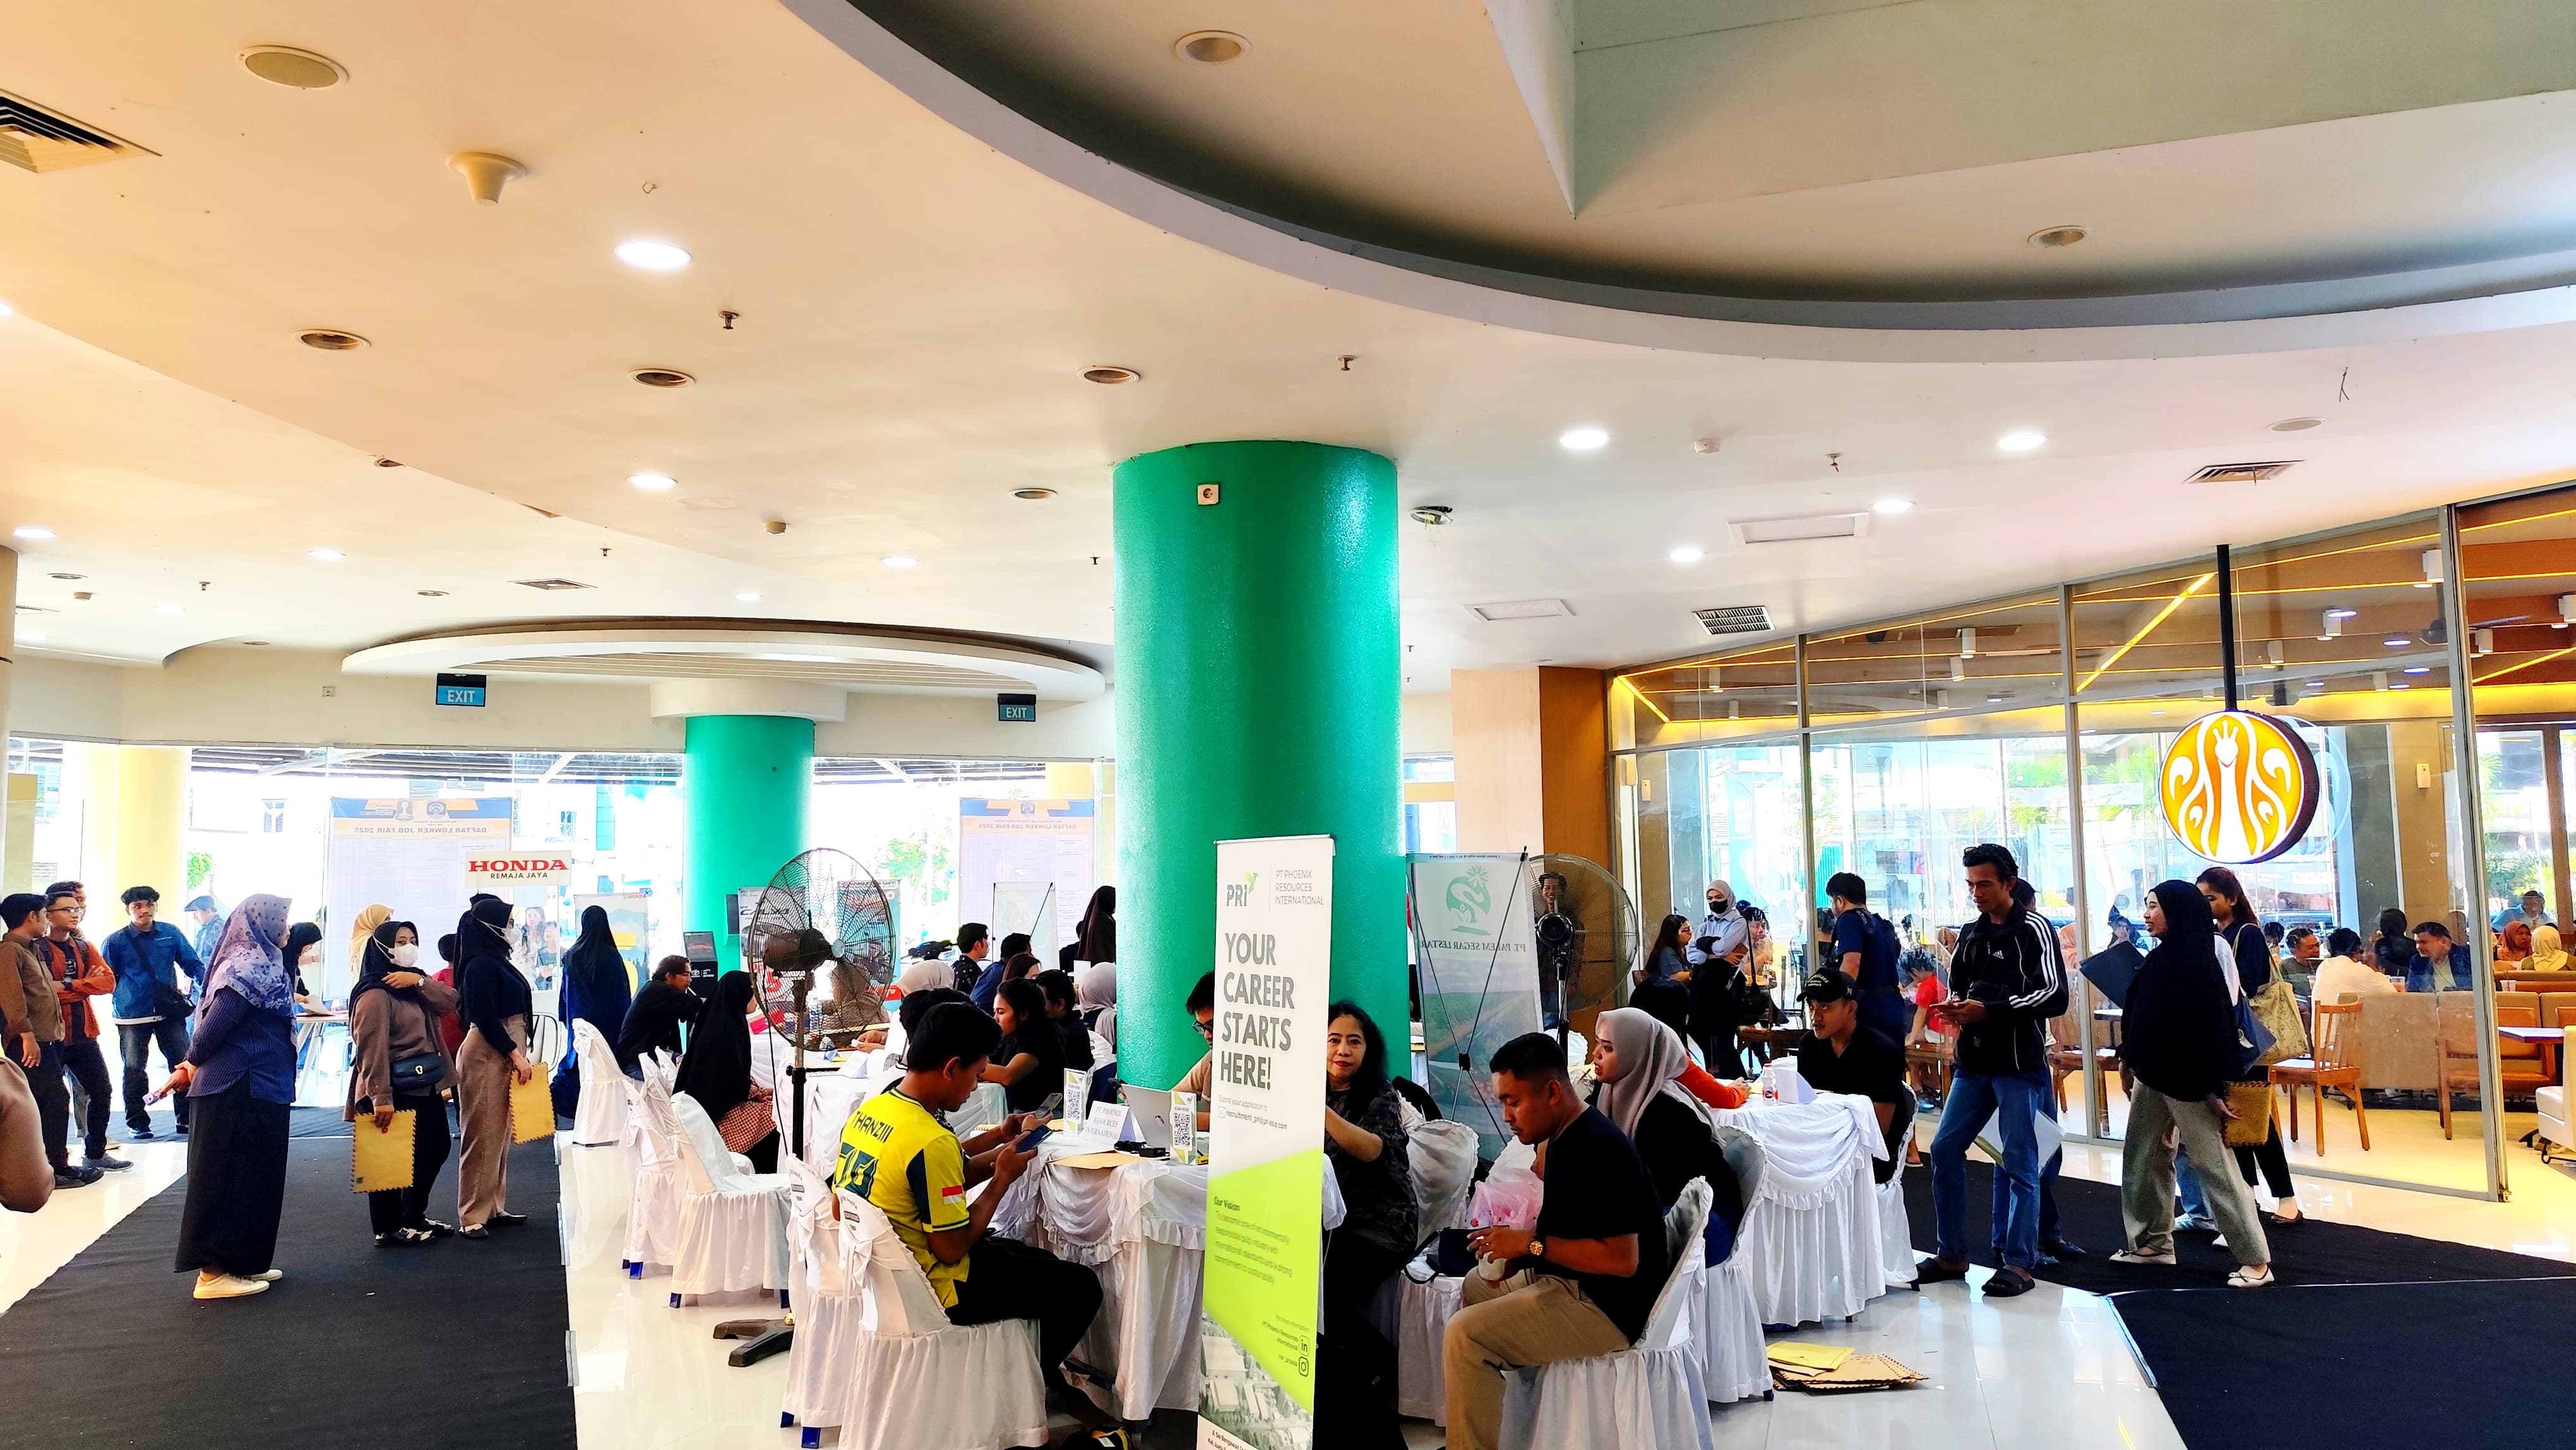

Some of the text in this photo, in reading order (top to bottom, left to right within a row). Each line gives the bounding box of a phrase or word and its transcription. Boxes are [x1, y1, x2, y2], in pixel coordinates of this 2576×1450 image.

[448, 690, 475, 703] EXIT
[1006, 707, 1027, 718] EXIT
[468, 860, 569, 872] HONDA
[1276, 870, 1313, 878] PT PHOENIX
[1275, 883, 1313, 892] RESOURCES
[1226, 884, 1248, 907] PRI
[1275, 896, 1324, 905] INTERNATIONAL
[1225, 932, 1277, 966] YOUR
[1223, 971, 1296, 1010] CAREER
[1222, 1010, 1292, 1052] STARTS
[1220, 1050, 1271, 1091] HERE!
